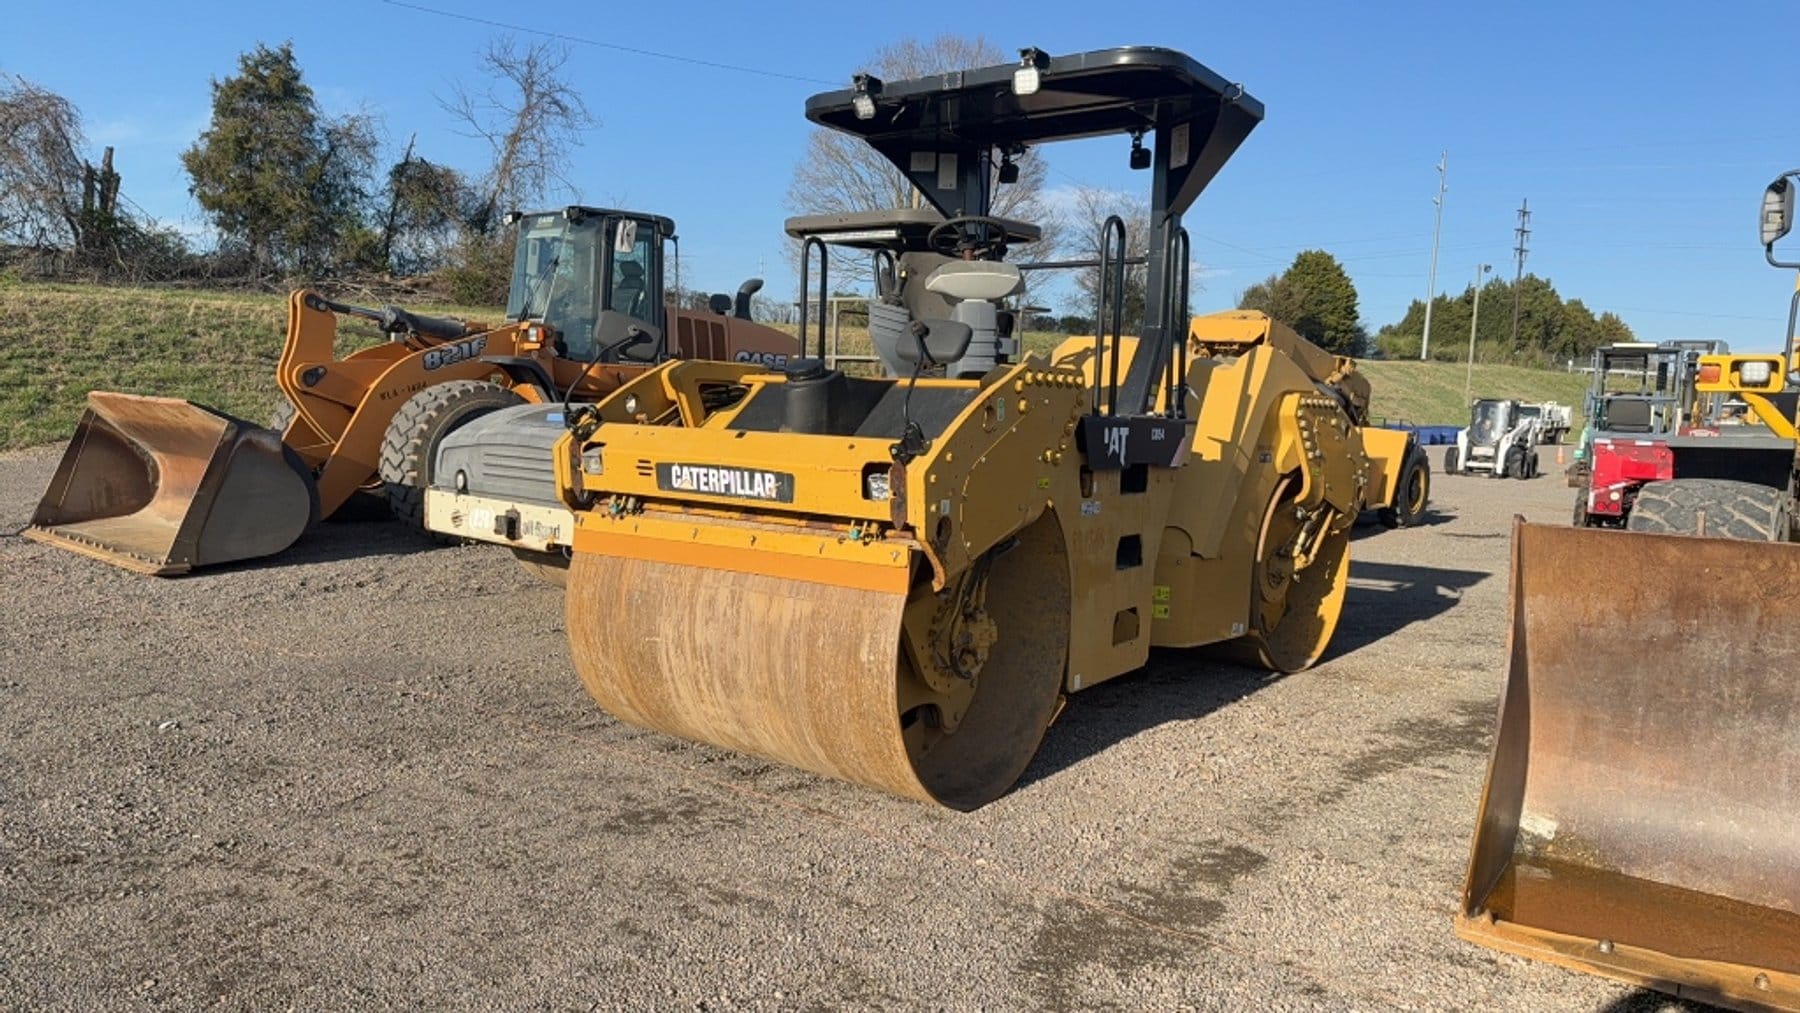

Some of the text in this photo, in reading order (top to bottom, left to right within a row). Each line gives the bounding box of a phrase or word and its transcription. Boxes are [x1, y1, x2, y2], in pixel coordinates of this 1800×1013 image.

[424, 335, 487, 370] 821F
[736, 350, 787, 370] CASE
[671, 464, 778, 499] CATERPILLAR
